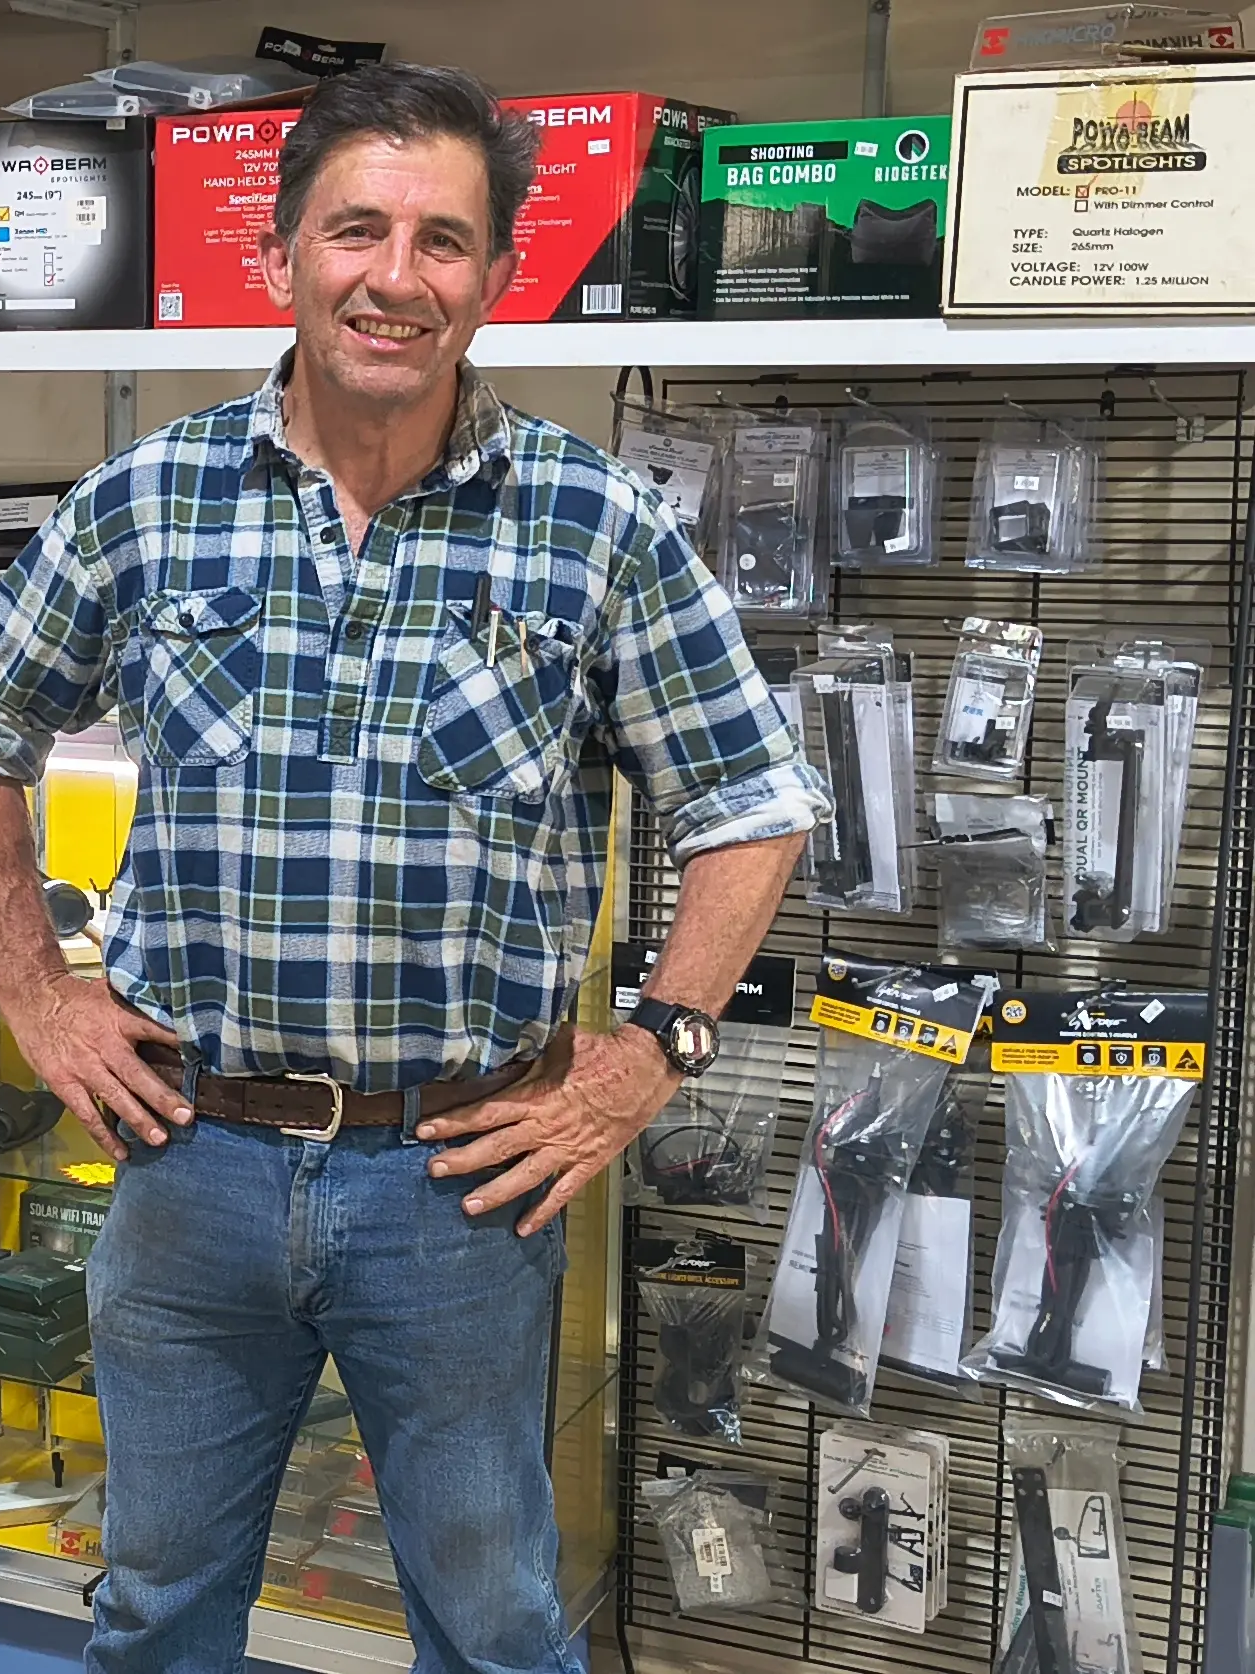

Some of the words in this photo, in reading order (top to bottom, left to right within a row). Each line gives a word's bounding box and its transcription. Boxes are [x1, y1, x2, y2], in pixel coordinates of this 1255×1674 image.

[1009, 23, 1115, 44] HIKMICRO
[653, 106, 689, 130] POWA
[172, 123, 254, 144] POWA
[235, 149, 273, 160] 245MM
[751, 145, 814, 161] SHOOTING
[51, 157, 107, 171] BEAM
[244, 163, 260, 173] 12V
[263, 162, 278, 171] 70
[536, 163, 576, 174] TLIGHT
[1067, 154, 1196, 171] SPOTLIGHTS
[727, 165, 763, 186] BAG
[769, 163, 836, 185] COMBO
[875, 164, 948, 182] RIDGETEK
[51, 175, 107, 184] SPOTLIGHTS
[204, 177, 234, 188] HAND
[1016, 186, 1070, 198] MODEL:
[1094, 200, 1118, 210] With
[1121, 200, 1167, 209] Dimmer
[1170, 199, 1214, 209] Control
[1013, 229, 1048, 239] TYPE:
[1072, 227, 1111, 238] Quartz
[1113, 227, 1163, 238] Halogen
[1012, 243, 1042, 253] SIZE:
[1071, 243, 1113, 252] 265mm
[1011, 261, 1080, 273] VOLTAGE:
[1094, 262, 1115, 271] 12V
[1119, 262, 1149, 271] 100W
[1010, 275, 1066, 286] CANDLE
[1071, 276, 1125, 286] POWER:
[1135, 276, 1157, 286] 1.25
[1161, 276, 1209, 286] MILLION
[1076, 809, 1088, 831] QR
[736, 983, 763, 995] AM
[29, 1203, 58, 1219] SOLAR
[60, 1207, 79, 1222] WIFI
